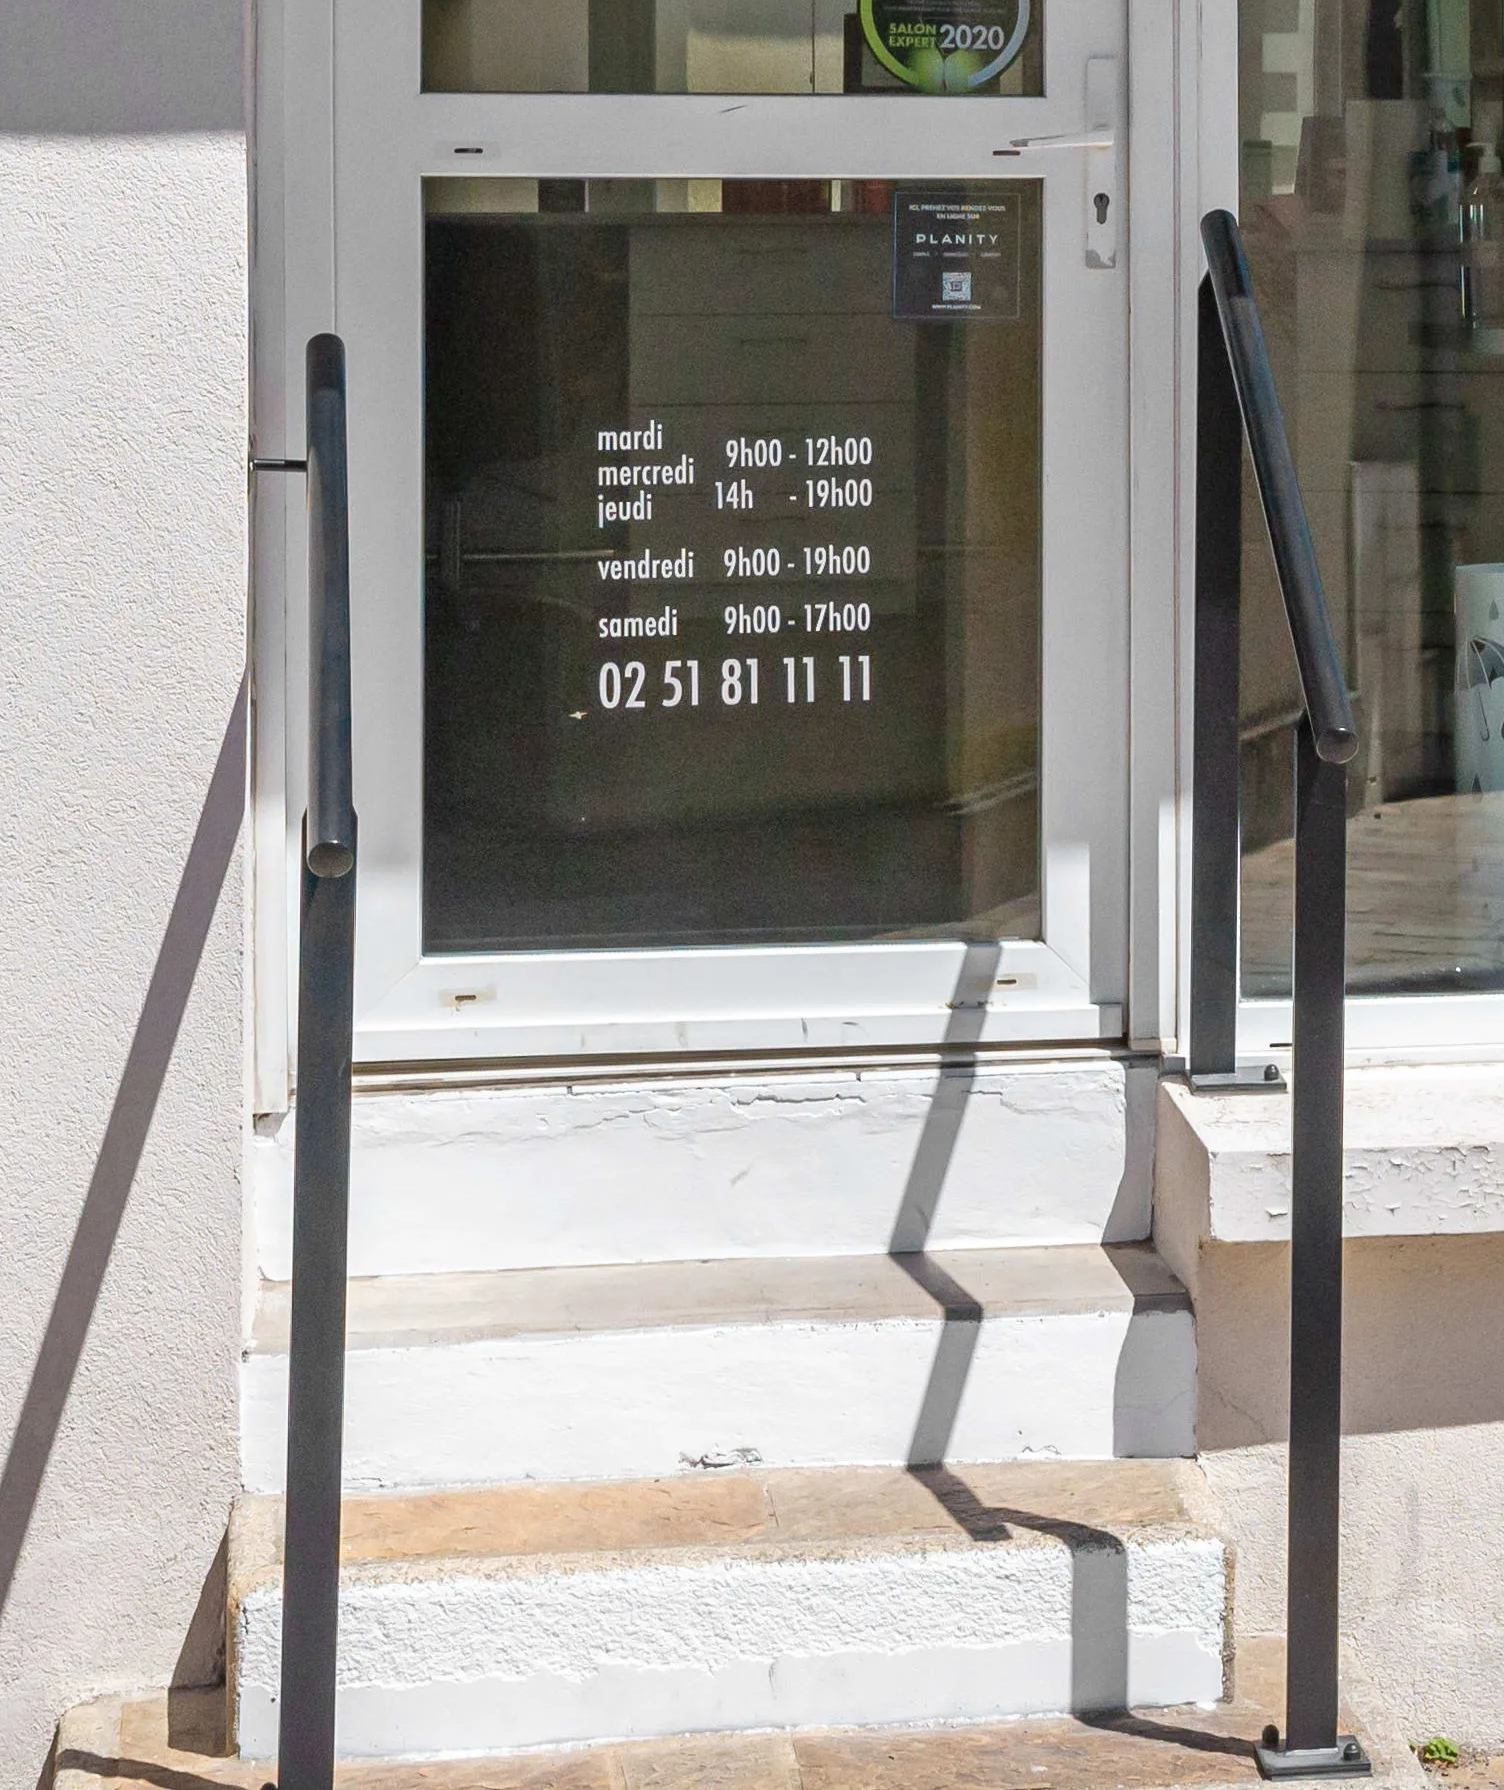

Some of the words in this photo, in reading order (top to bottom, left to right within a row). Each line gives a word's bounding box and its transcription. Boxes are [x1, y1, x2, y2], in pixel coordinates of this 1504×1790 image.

[889, 23, 937, 35] SALON
[889, 36, 937, 48] EXPERT
[939, 23, 1005, 51] 2020
[916, 233, 999, 244] PLANITY
[598, 420, 663, 451] mardi
[726, 438, 782, 468] 9h00
[805, 436, 872, 466] 12h00
[598, 454, 695, 486] mercredi
[715, 480, 753, 509] 14h
[805, 478, 872, 508] 19h00
[598, 491, 652, 528] jeudi
[598, 548, 694, 580] vendredi
[724, 547, 780, 577] 9h00
[804, 545, 871, 575] 19h00
[599, 606, 678, 638] samedi
[724, 604, 781, 634] 9h00
[804, 602, 871, 632] 17h00
[599, 661, 646, 709] 02
[662, 660, 699, 707] 51
[721, 658, 758, 705] 81
[784, 657, 815, 703] 11
[839, 655, 871, 702] 11
